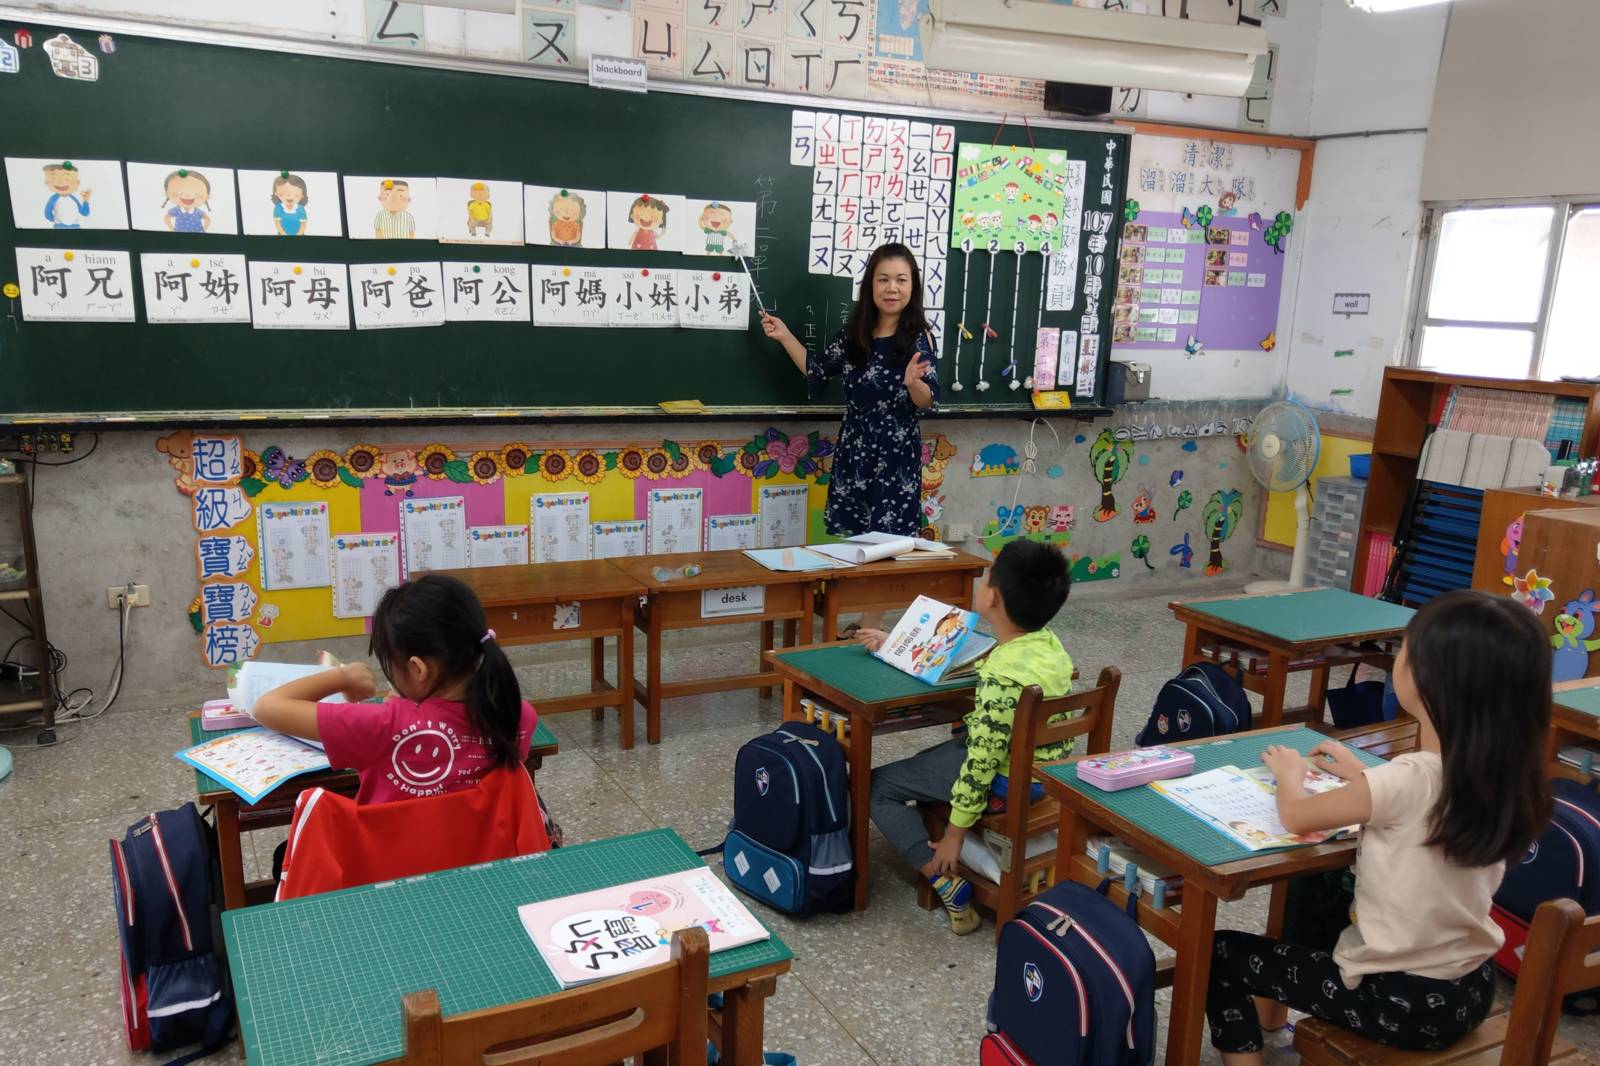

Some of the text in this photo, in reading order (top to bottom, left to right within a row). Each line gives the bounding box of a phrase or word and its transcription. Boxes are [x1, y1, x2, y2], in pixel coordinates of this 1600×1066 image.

[529, 22, 569, 62] ㄡ
[642, 20, 671, 58] ㄩ
[595, 63, 643, 79] blackboard
[693, 41, 725, 80] ㄙ
[792, 54, 822, 91] ㄒ
[829, 60, 861, 92] ㄏ
[821, 115, 833, 140] ㄑ
[844, 119, 861, 140] ㄒ
[936, 127, 952, 150] ㄅ
[819, 144, 836, 166] ㄓ
[841, 148, 859, 166] ㄈ
[1184, 142, 1225, 169] 清潔
[934, 157, 949, 177] ㄇ
[1101, 139, 1117, 205] 中華民國
[839, 174, 859, 194] ㄏ
[910, 180, 927, 200] ㄝ
[934, 183, 947, 204] ㄨ
[932, 209, 947, 231] ㄚ
[964, 239, 971, 251] 1
[990, 239, 998, 251] 2
[1016, 241, 1025, 253] 3
[1040, 241, 1050, 253] 4
[84, 254, 116, 264] hiann
[836, 254, 853, 275] ㄡ
[493, 265, 515, 276] kong
[31, 265, 123, 299] 阿兄
[154, 269, 239, 305] 阿姊
[361, 275, 436, 308] 阿爸
[453, 275, 522, 305] 阿公
[261, 277, 340, 310] 阿母
[541, 278, 606, 309] 阿媽
[616, 280, 679, 312] 小妹
[685, 283, 742, 315] 小弟
[1344, 300, 1358, 308] wall
[192, 438, 239, 665] 超級寶寶榜
[721, 592, 748, 605] desk
[392, 720, 432, 742] Don't
[438, 721, 461, 751] Worry
[386, 772, 398, 786] Be
